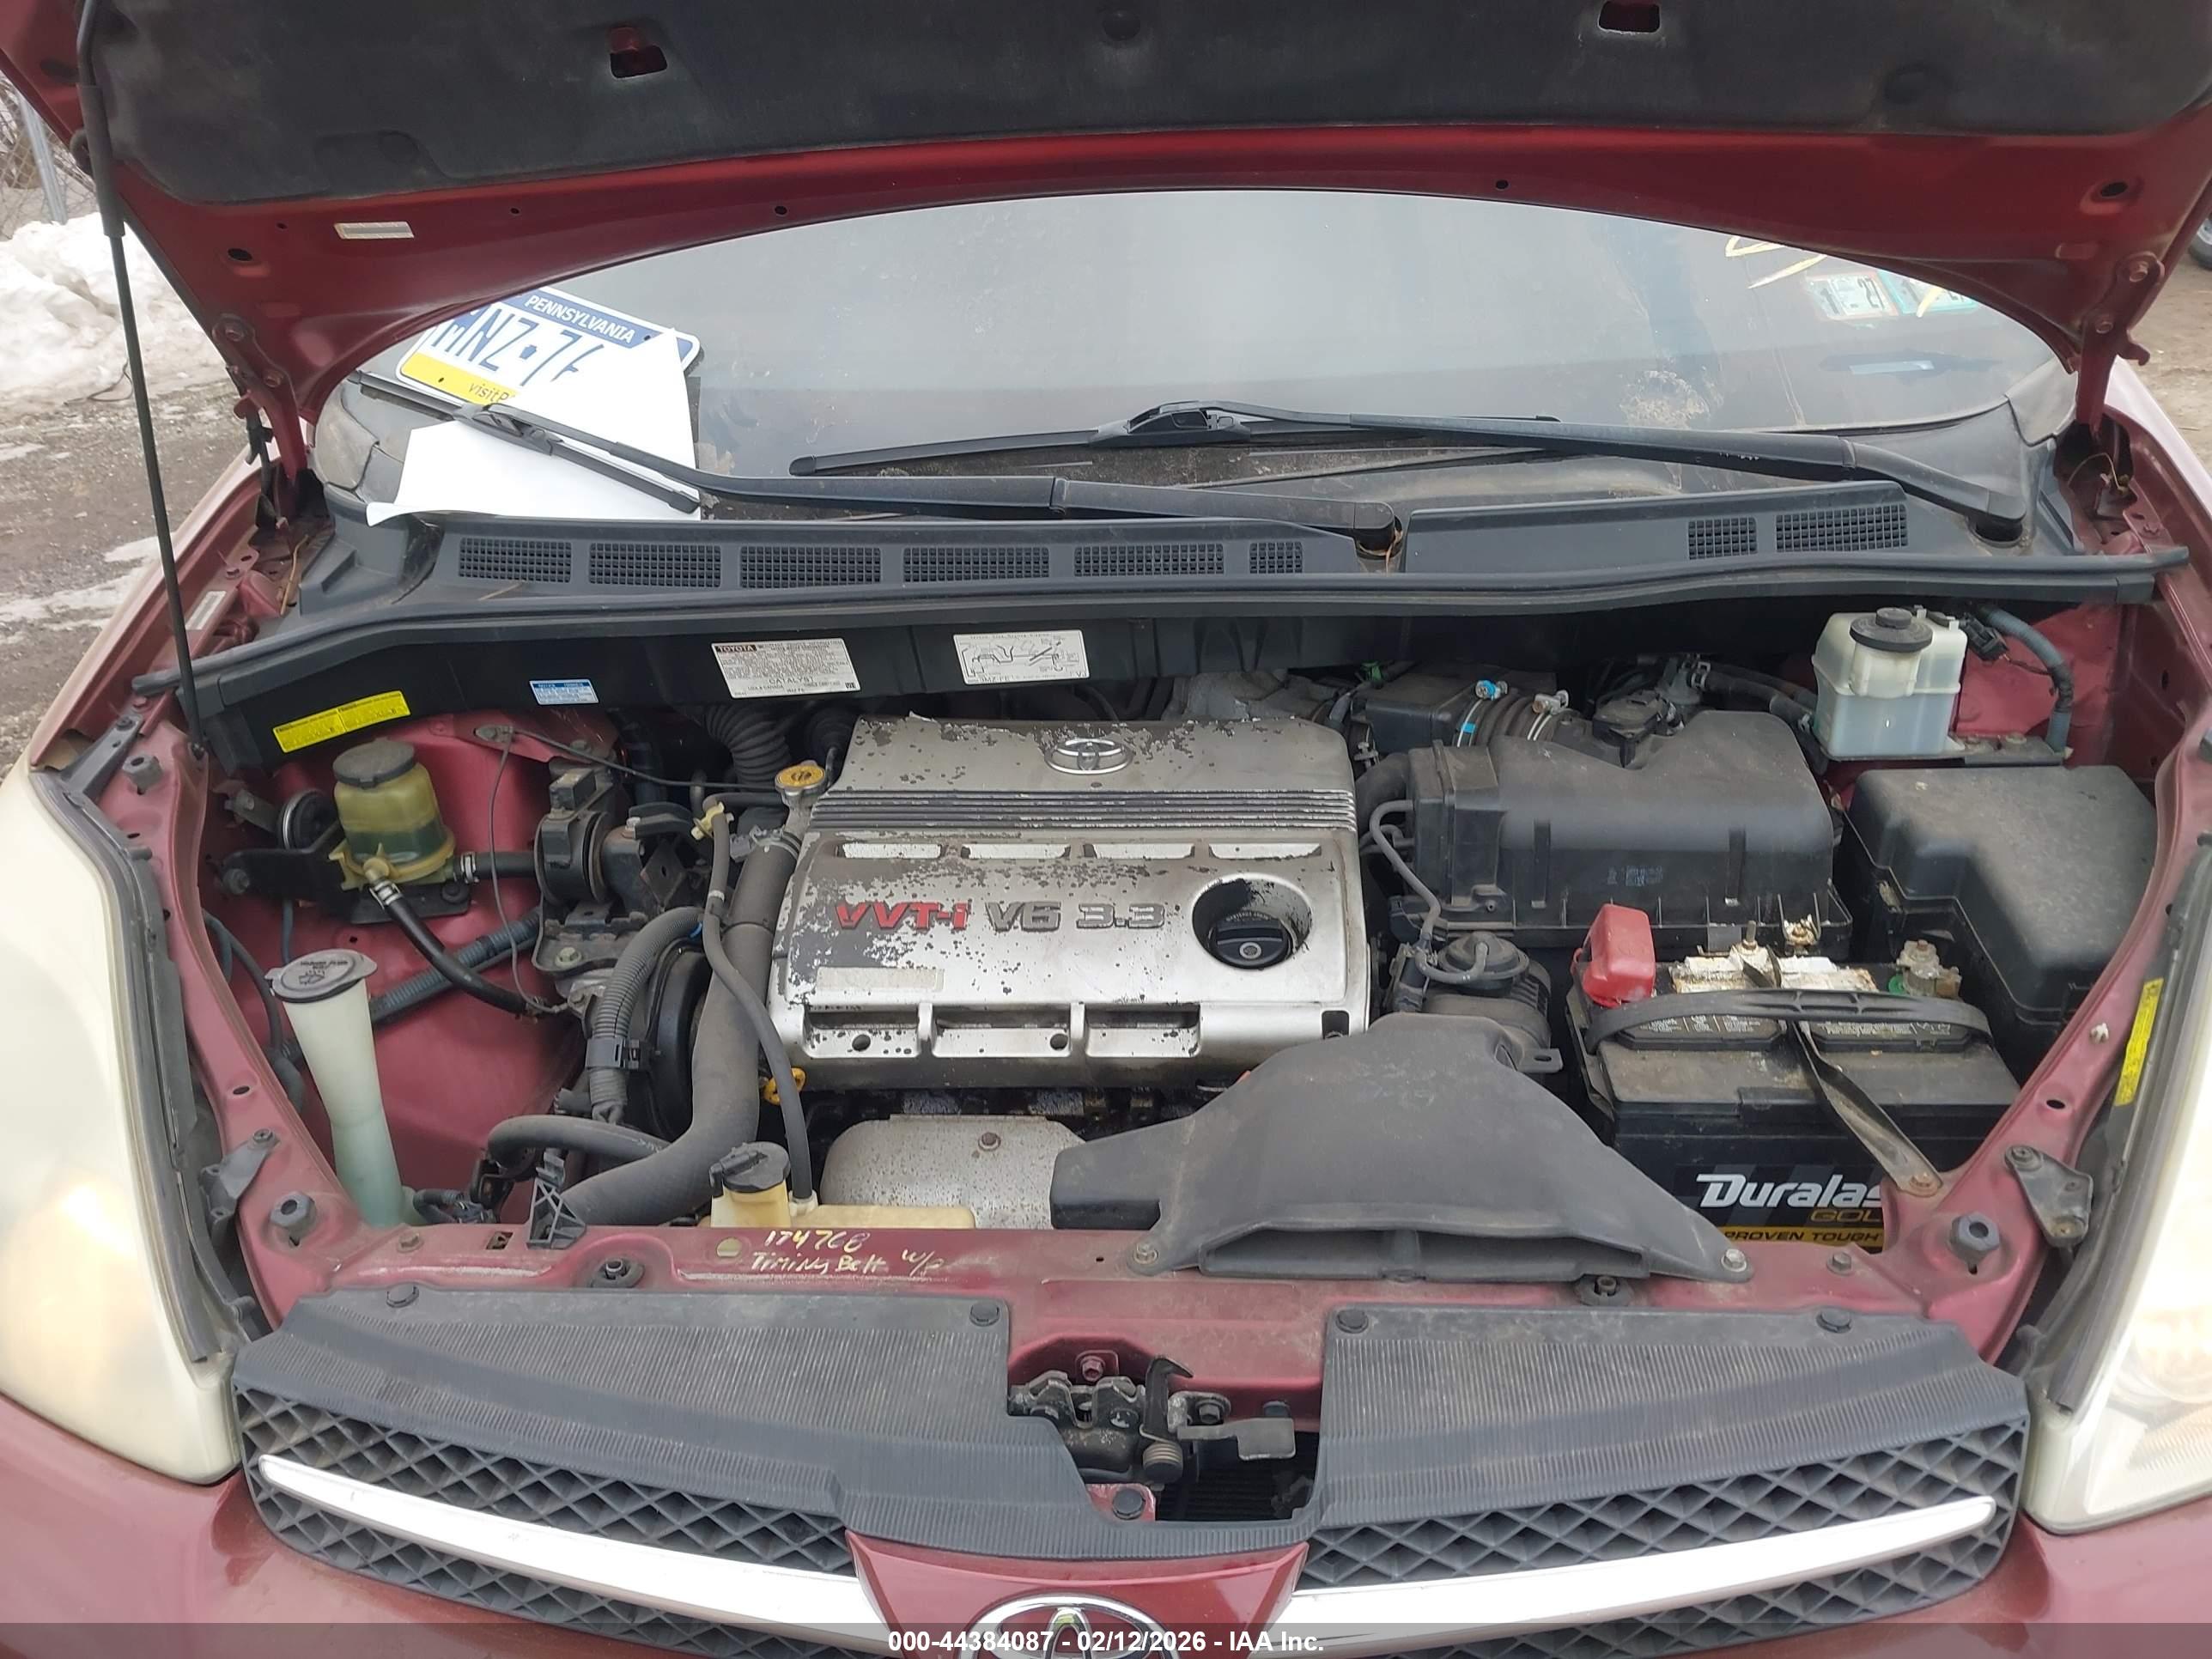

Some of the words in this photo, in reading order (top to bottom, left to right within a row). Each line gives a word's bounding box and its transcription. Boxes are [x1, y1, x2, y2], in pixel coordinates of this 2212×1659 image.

[525, 295, 635, 343] PENNSYLVANIA
[986, 902, 1061, 932] V6
[1076, 903, 1164, 929] 3.3
[1724, 1231, 1804, 1241] PROVEN
[1812, 1231, 1879, 1242] TOUGH
